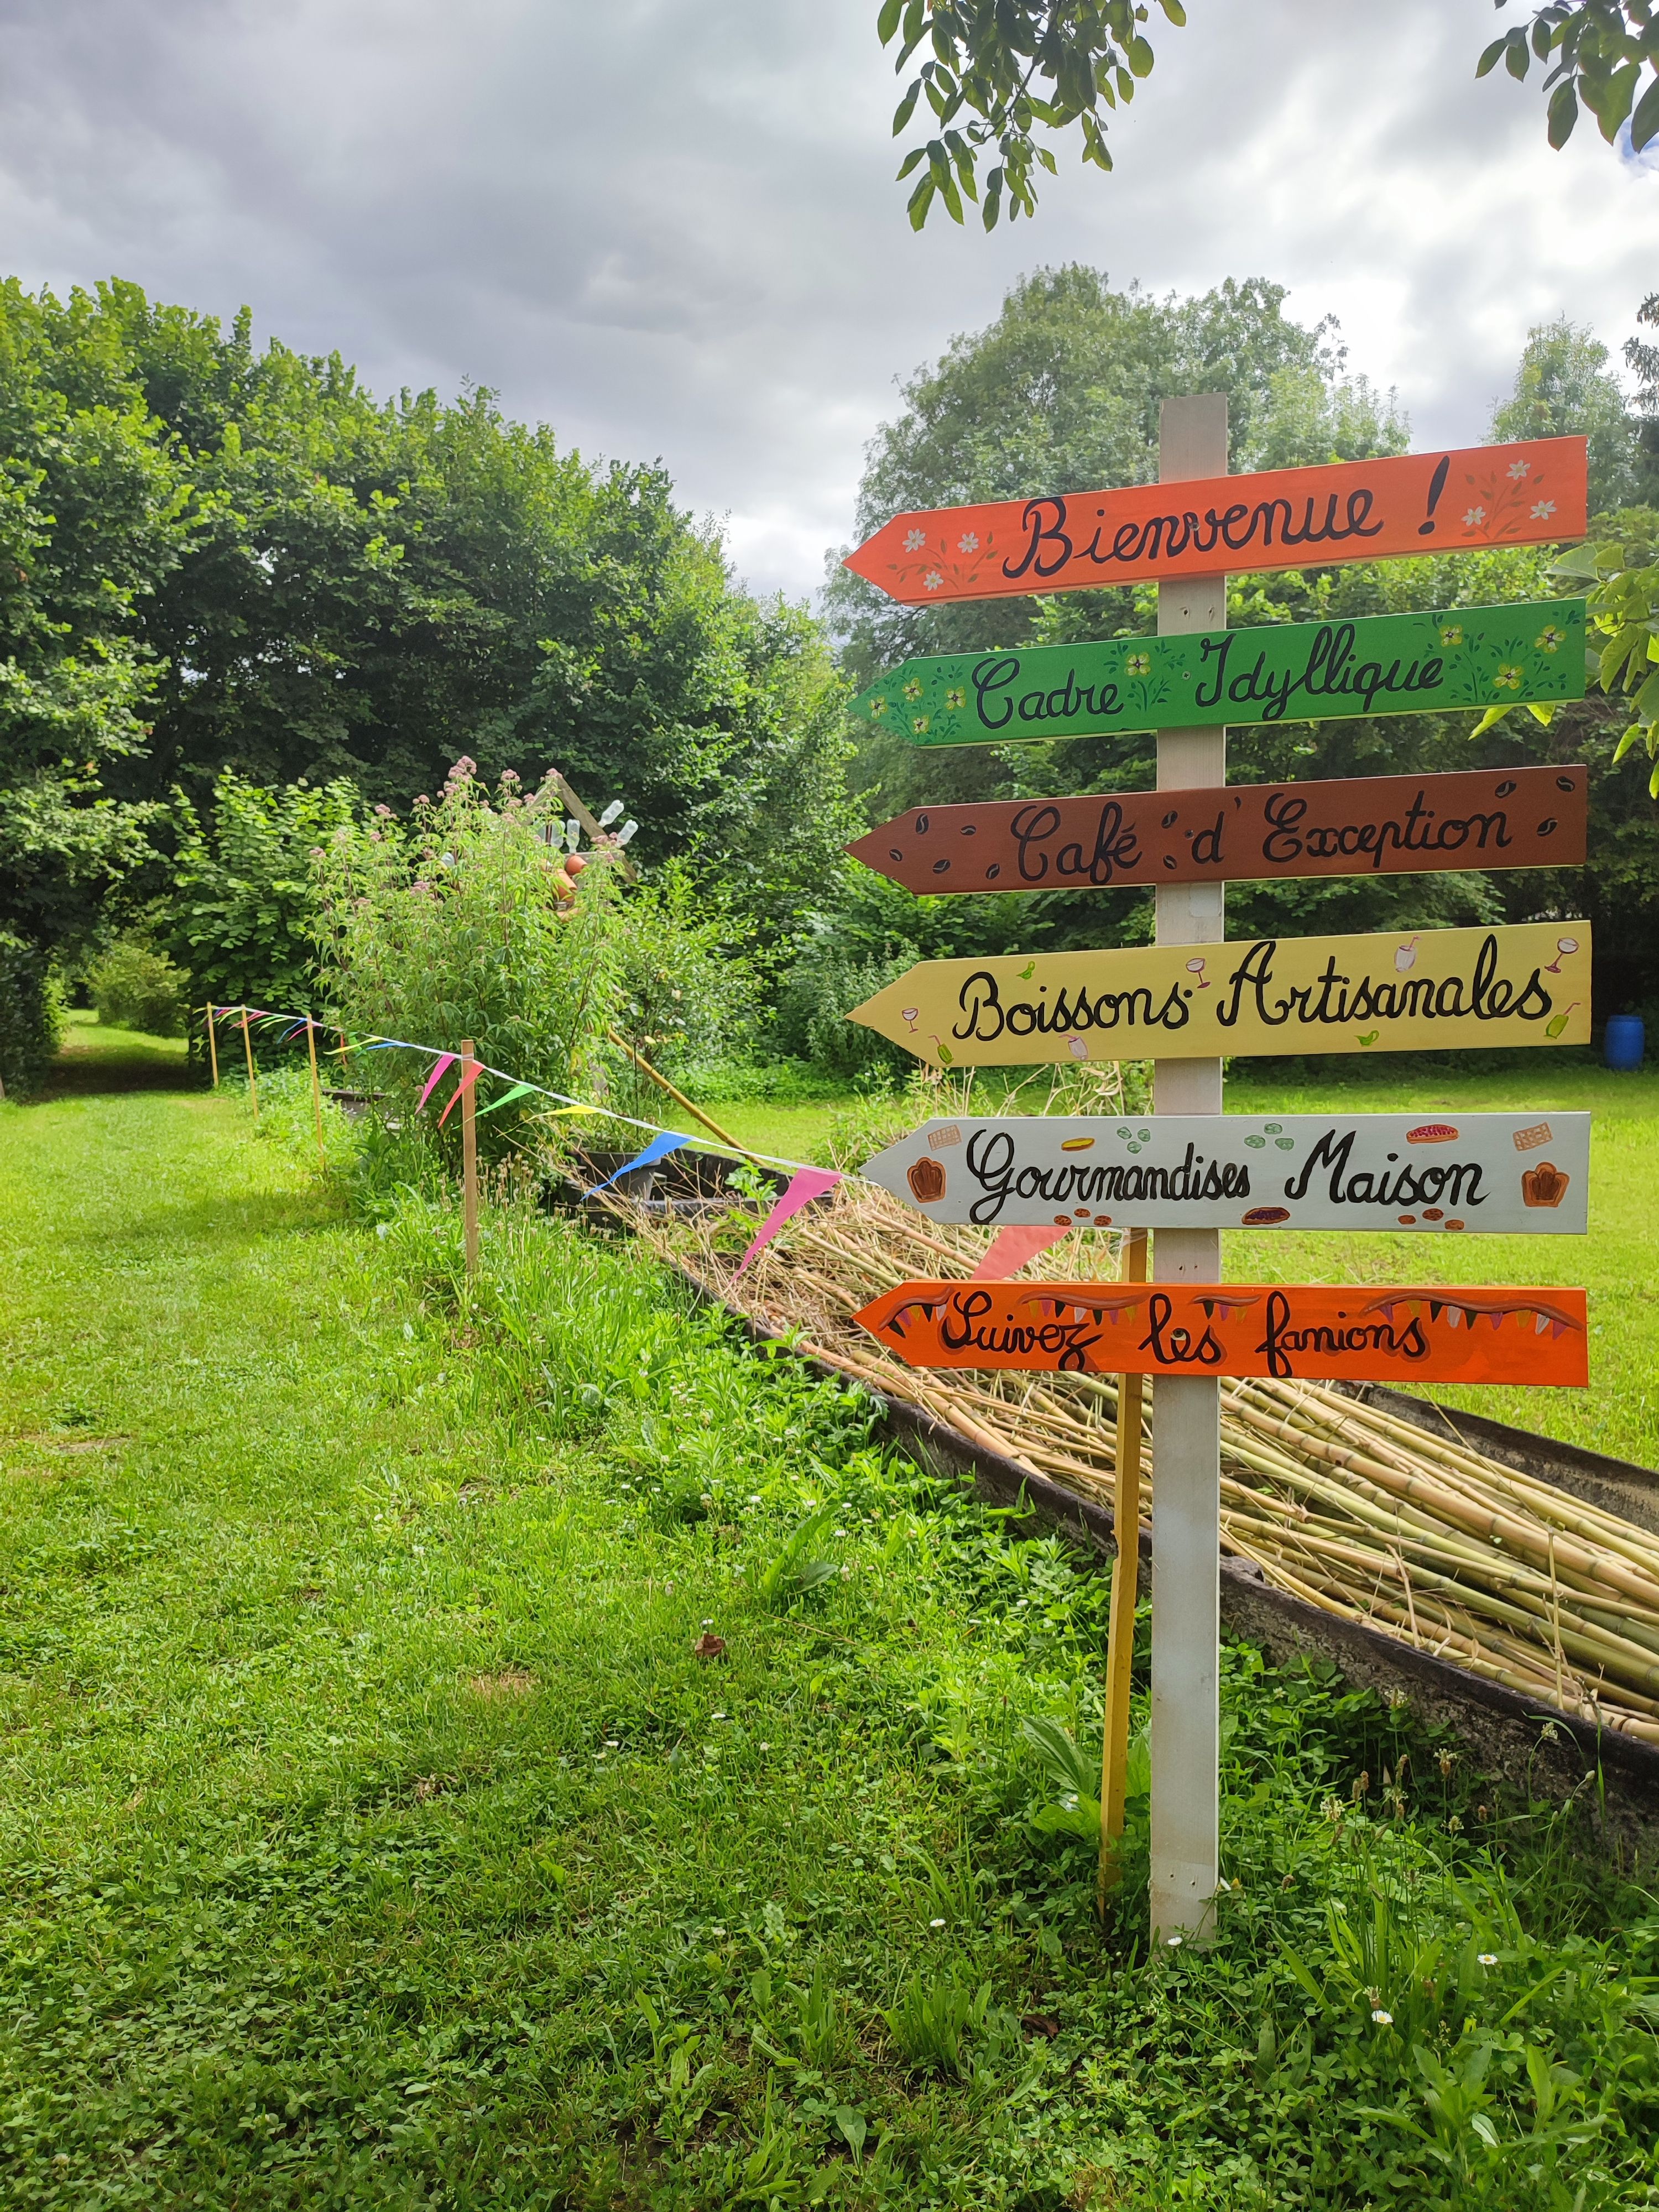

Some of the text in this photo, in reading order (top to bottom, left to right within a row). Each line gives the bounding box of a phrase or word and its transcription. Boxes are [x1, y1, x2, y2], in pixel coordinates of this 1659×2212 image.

[1003, 495, 1383, 579] Bienvenue
[972, 623, 1443, 729] Cadre Idyllique
[1011, 801, 1142, 885] Café
[1263, 790, 1512, 869] Exception
[952, 933, 1553, 1042] Boissons Artisanales
[966, 1128, 1490, 1225] Gourmandises Maison
[941, 1290, 1427, 1379] Suivez les fanions
